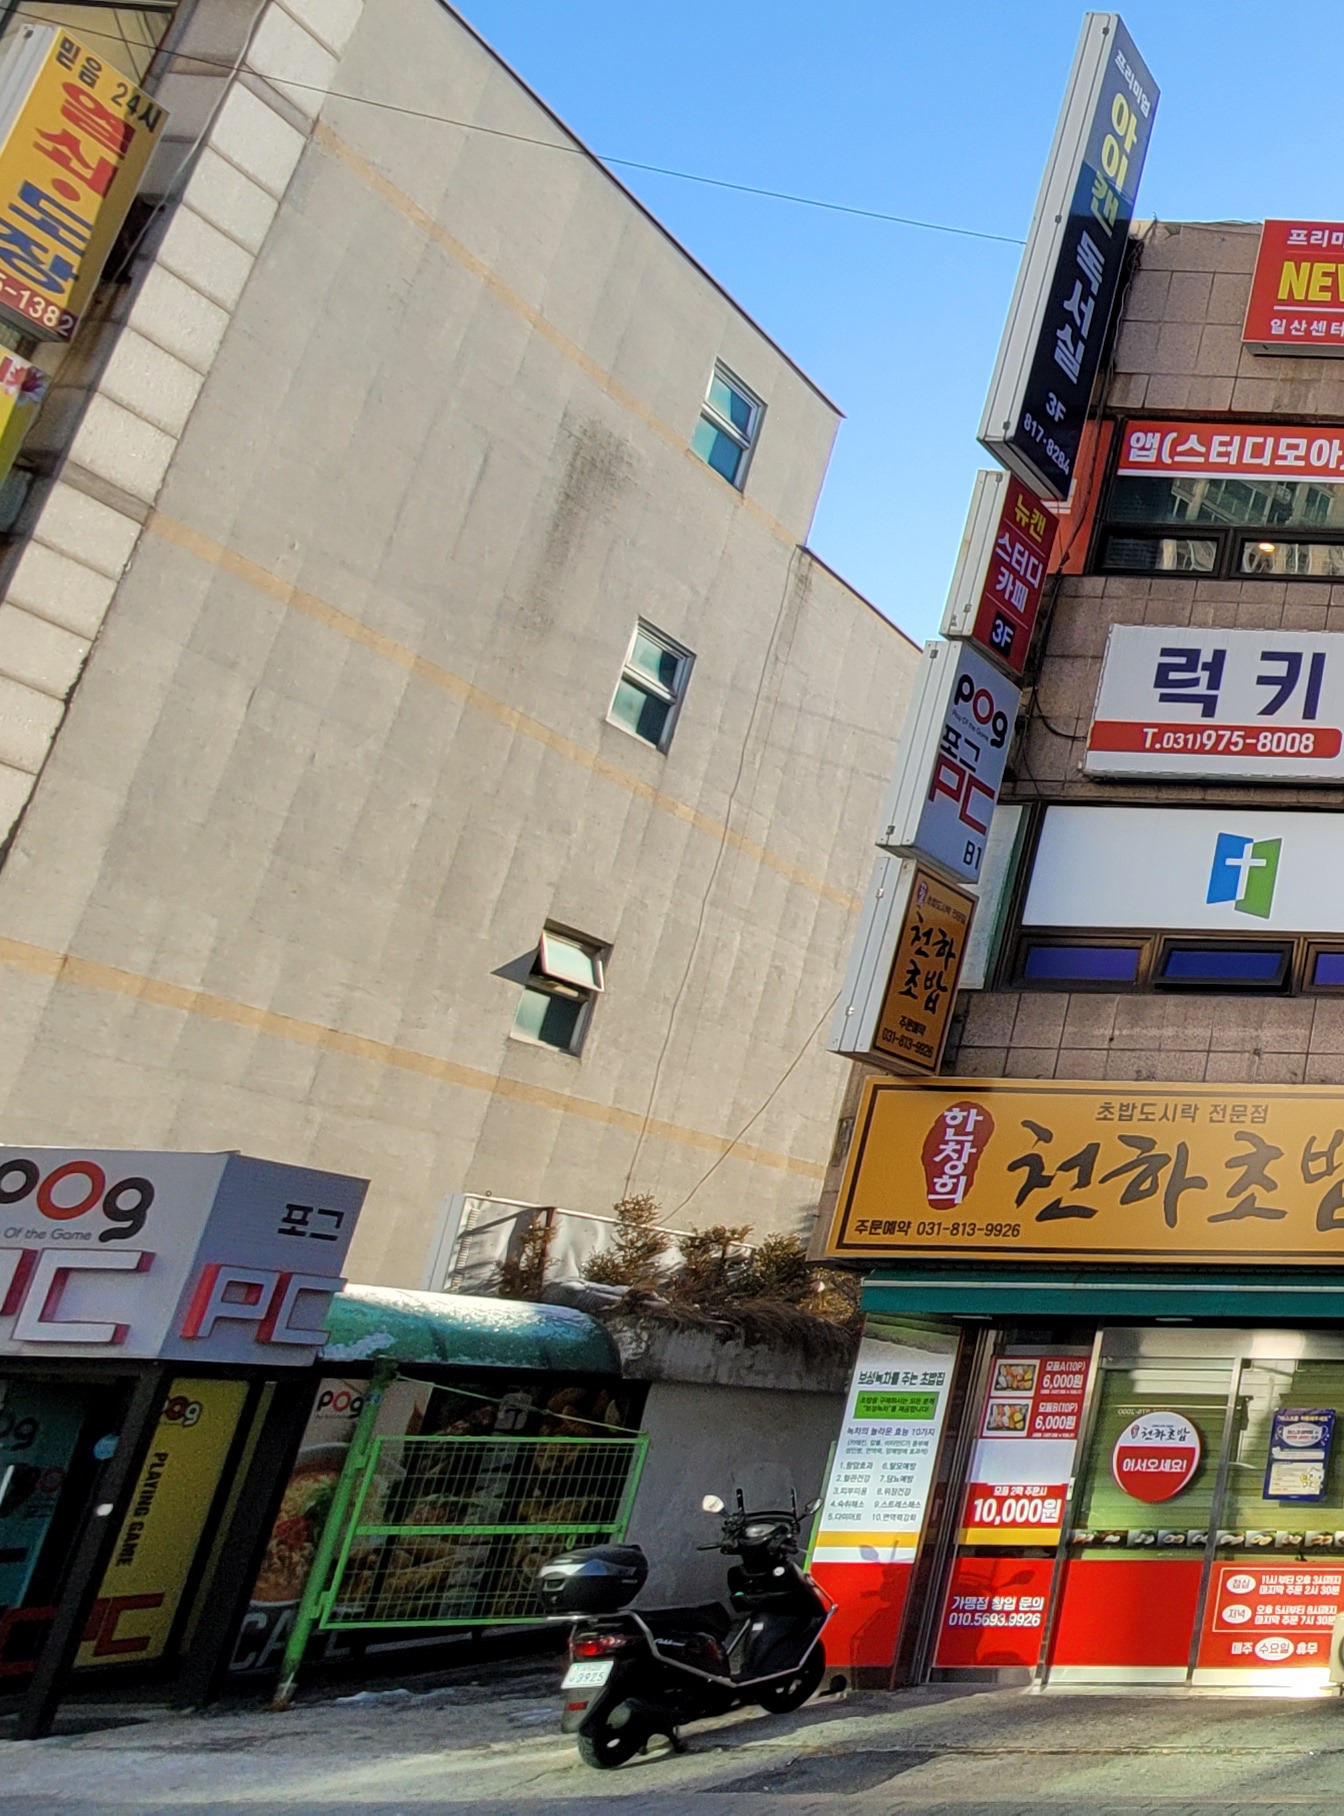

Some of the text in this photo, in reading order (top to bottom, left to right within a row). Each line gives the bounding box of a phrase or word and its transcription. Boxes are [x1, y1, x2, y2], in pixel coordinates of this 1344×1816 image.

[55, 38, 161, 135] 믿음 24시
[1114, 50, 1152, 118] 프리미엄
[1090, 92, 1138, 239] 아이캔
[1054, 229, 1106, 385] 독서실
[1045, 392, 1067, 422] 3F
[1014, 493, 1047, 544] 뉴캔
[996, 531, 1044, 589] 스터디
[995, 566, 1029, 614] 카페
[991, 619, 1015, 649] 3F
[1153, 646, 1325, 721] 럭키
[953, 673, 1009, 750] pog
[940, 723, 982, 774] 포그
[928, 752, 997, 838] PC
[962, 840, 983, 871] B1
[910, 910, 957, 971] 천하
[898, 958, 949, 1016] 초밥
[1095, 1102, 1270, 1125] 초밥도시락 전문점
[925, 1106, 984, 1206] 한창희
[26, 1228, 48, 1240] the
[51, 1228, 92, 1242] Game
[277, 1203, 345, 1242] 포그
[854, 1218, 1022, 1239] 주문예약 031-813-9926
[180, 1263, 348, 1345] PC
[901, 1371, 919, 1386] 주는
[919, 1372, 946, 1386] 초밥집
[1043, 1374, 1084, 1389] 6,000원
[1035, 1416, 1077, 1430] 6,000원
[1122, 1458, 1187, 1473] 어서오세요!
[115, 1452, 169, 1568] PLAYING GAME
[973, 1497, 1063, 1526] 10,000원
[948, 1612, 1042, 1628] 010.5693.9926
[951, 1596, 1045, 1612] 가맹점 창업 문의
[1258, 1642, 1291, 1655] 수요일
